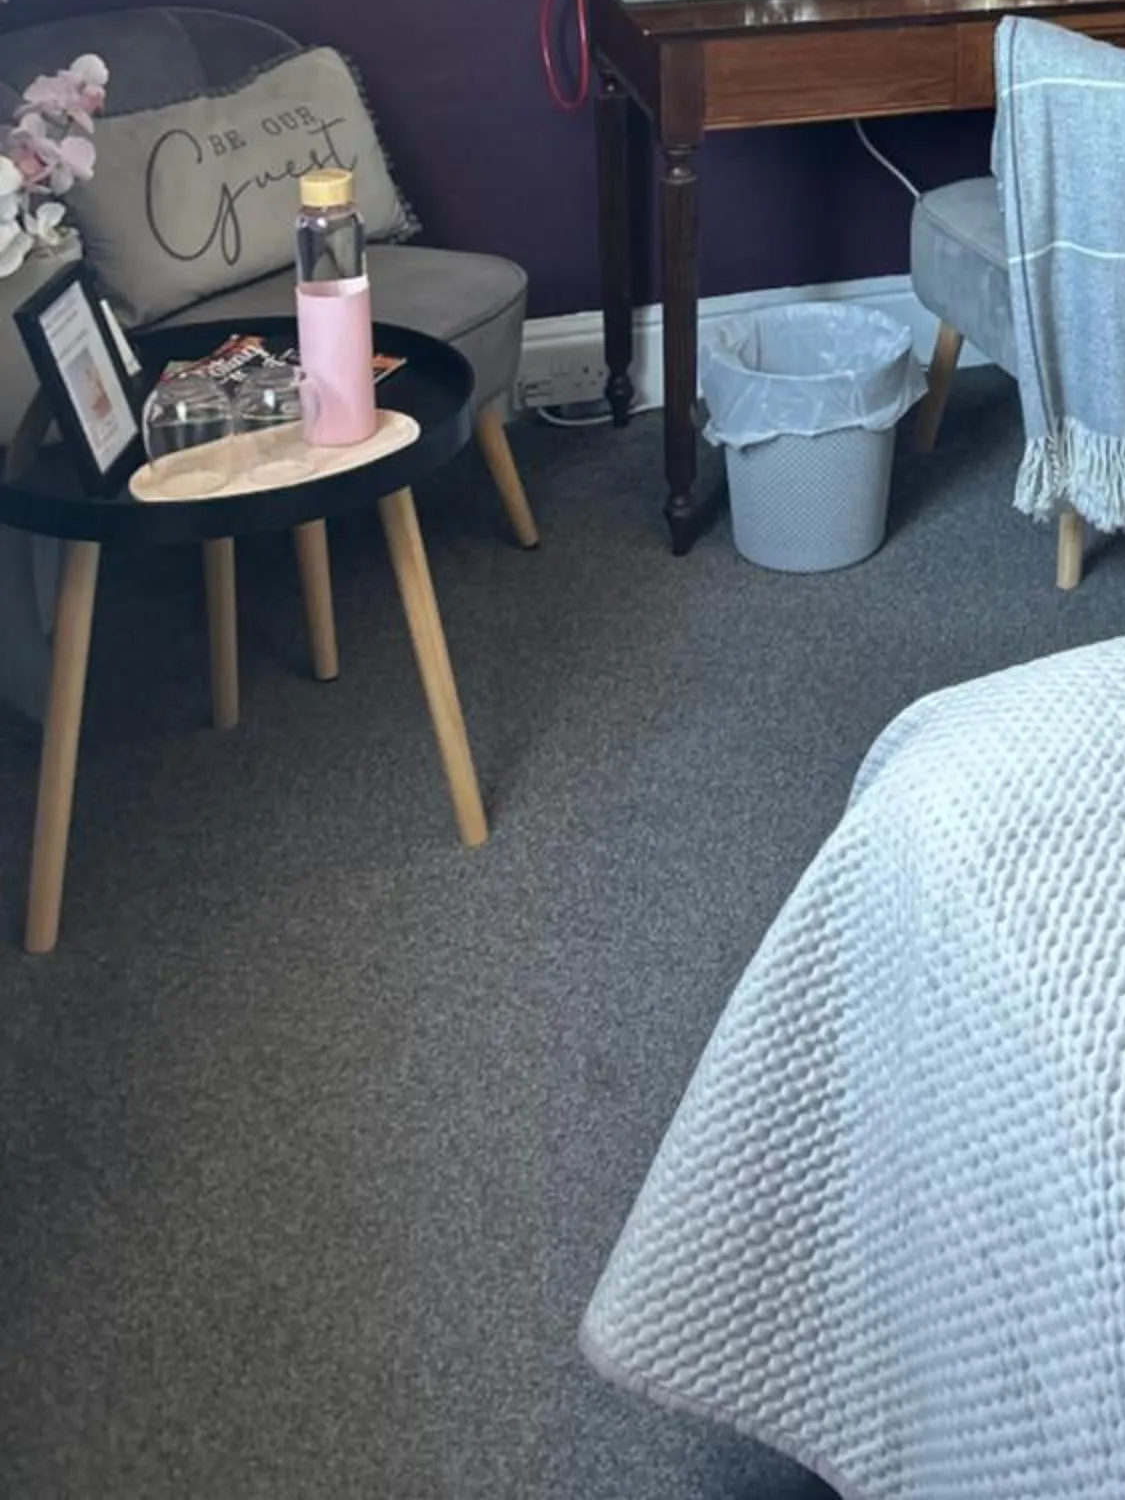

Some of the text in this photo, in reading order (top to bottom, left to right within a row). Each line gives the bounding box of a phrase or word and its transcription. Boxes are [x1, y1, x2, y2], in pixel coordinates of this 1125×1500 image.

[208, 106, 316, 156] BE OUR
[146, 117, 357, 266] Guest
